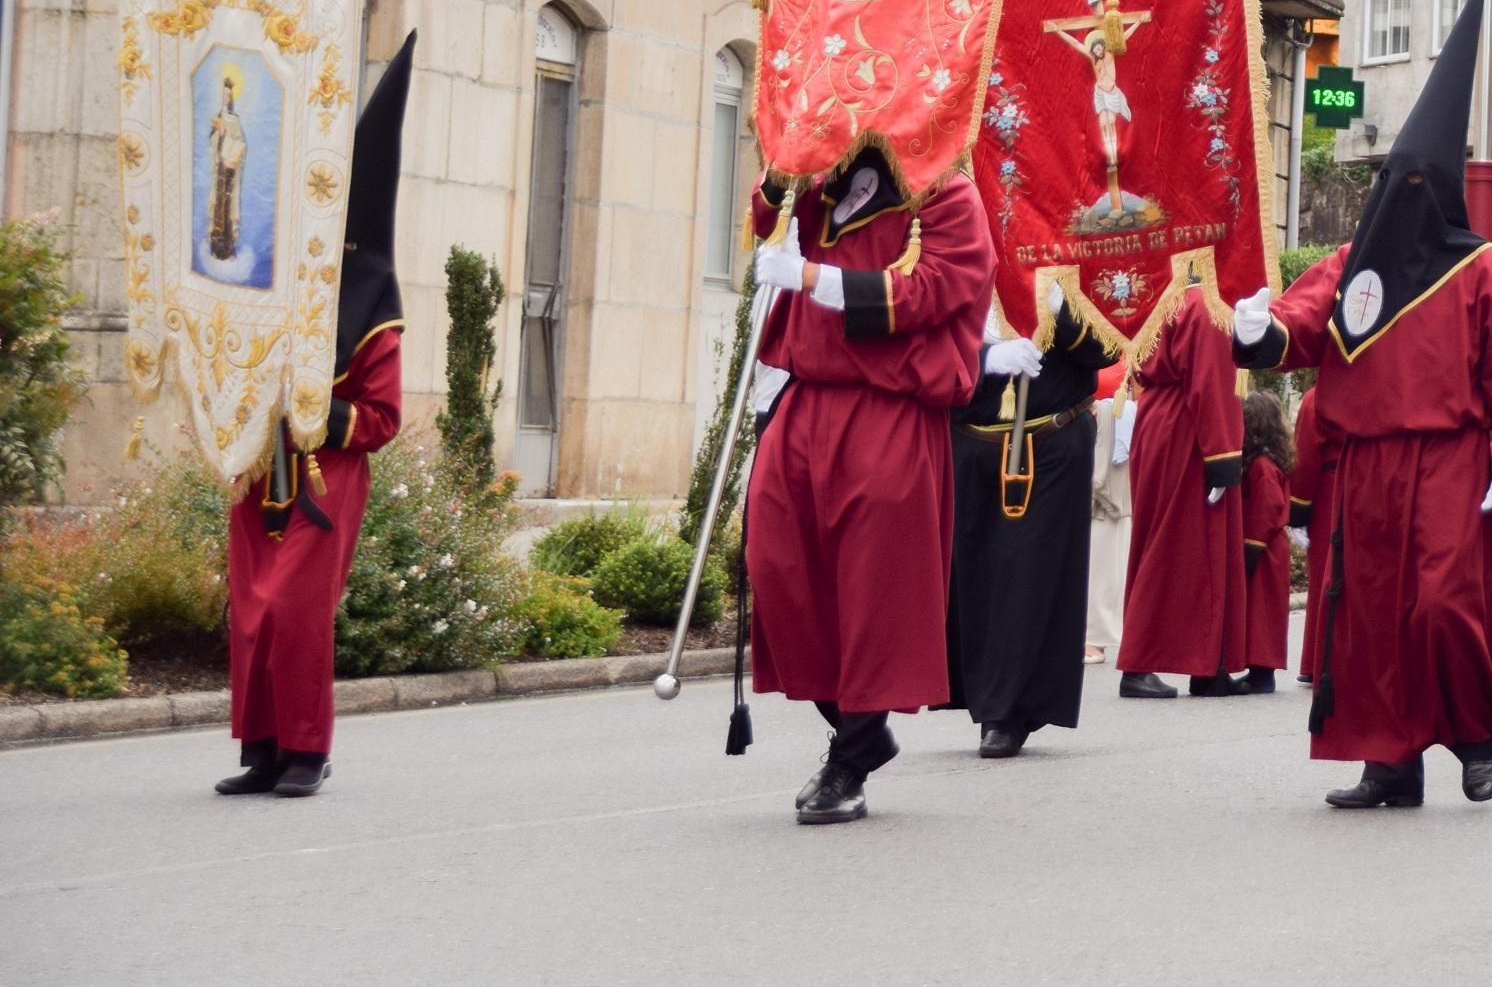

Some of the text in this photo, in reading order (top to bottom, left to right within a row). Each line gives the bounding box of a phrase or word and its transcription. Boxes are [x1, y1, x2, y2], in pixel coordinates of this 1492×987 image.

[1312, 88, 1356, 108] 12:36
[1016, 222, 1228, 263] DE LA VICTORIA DE PETAN
